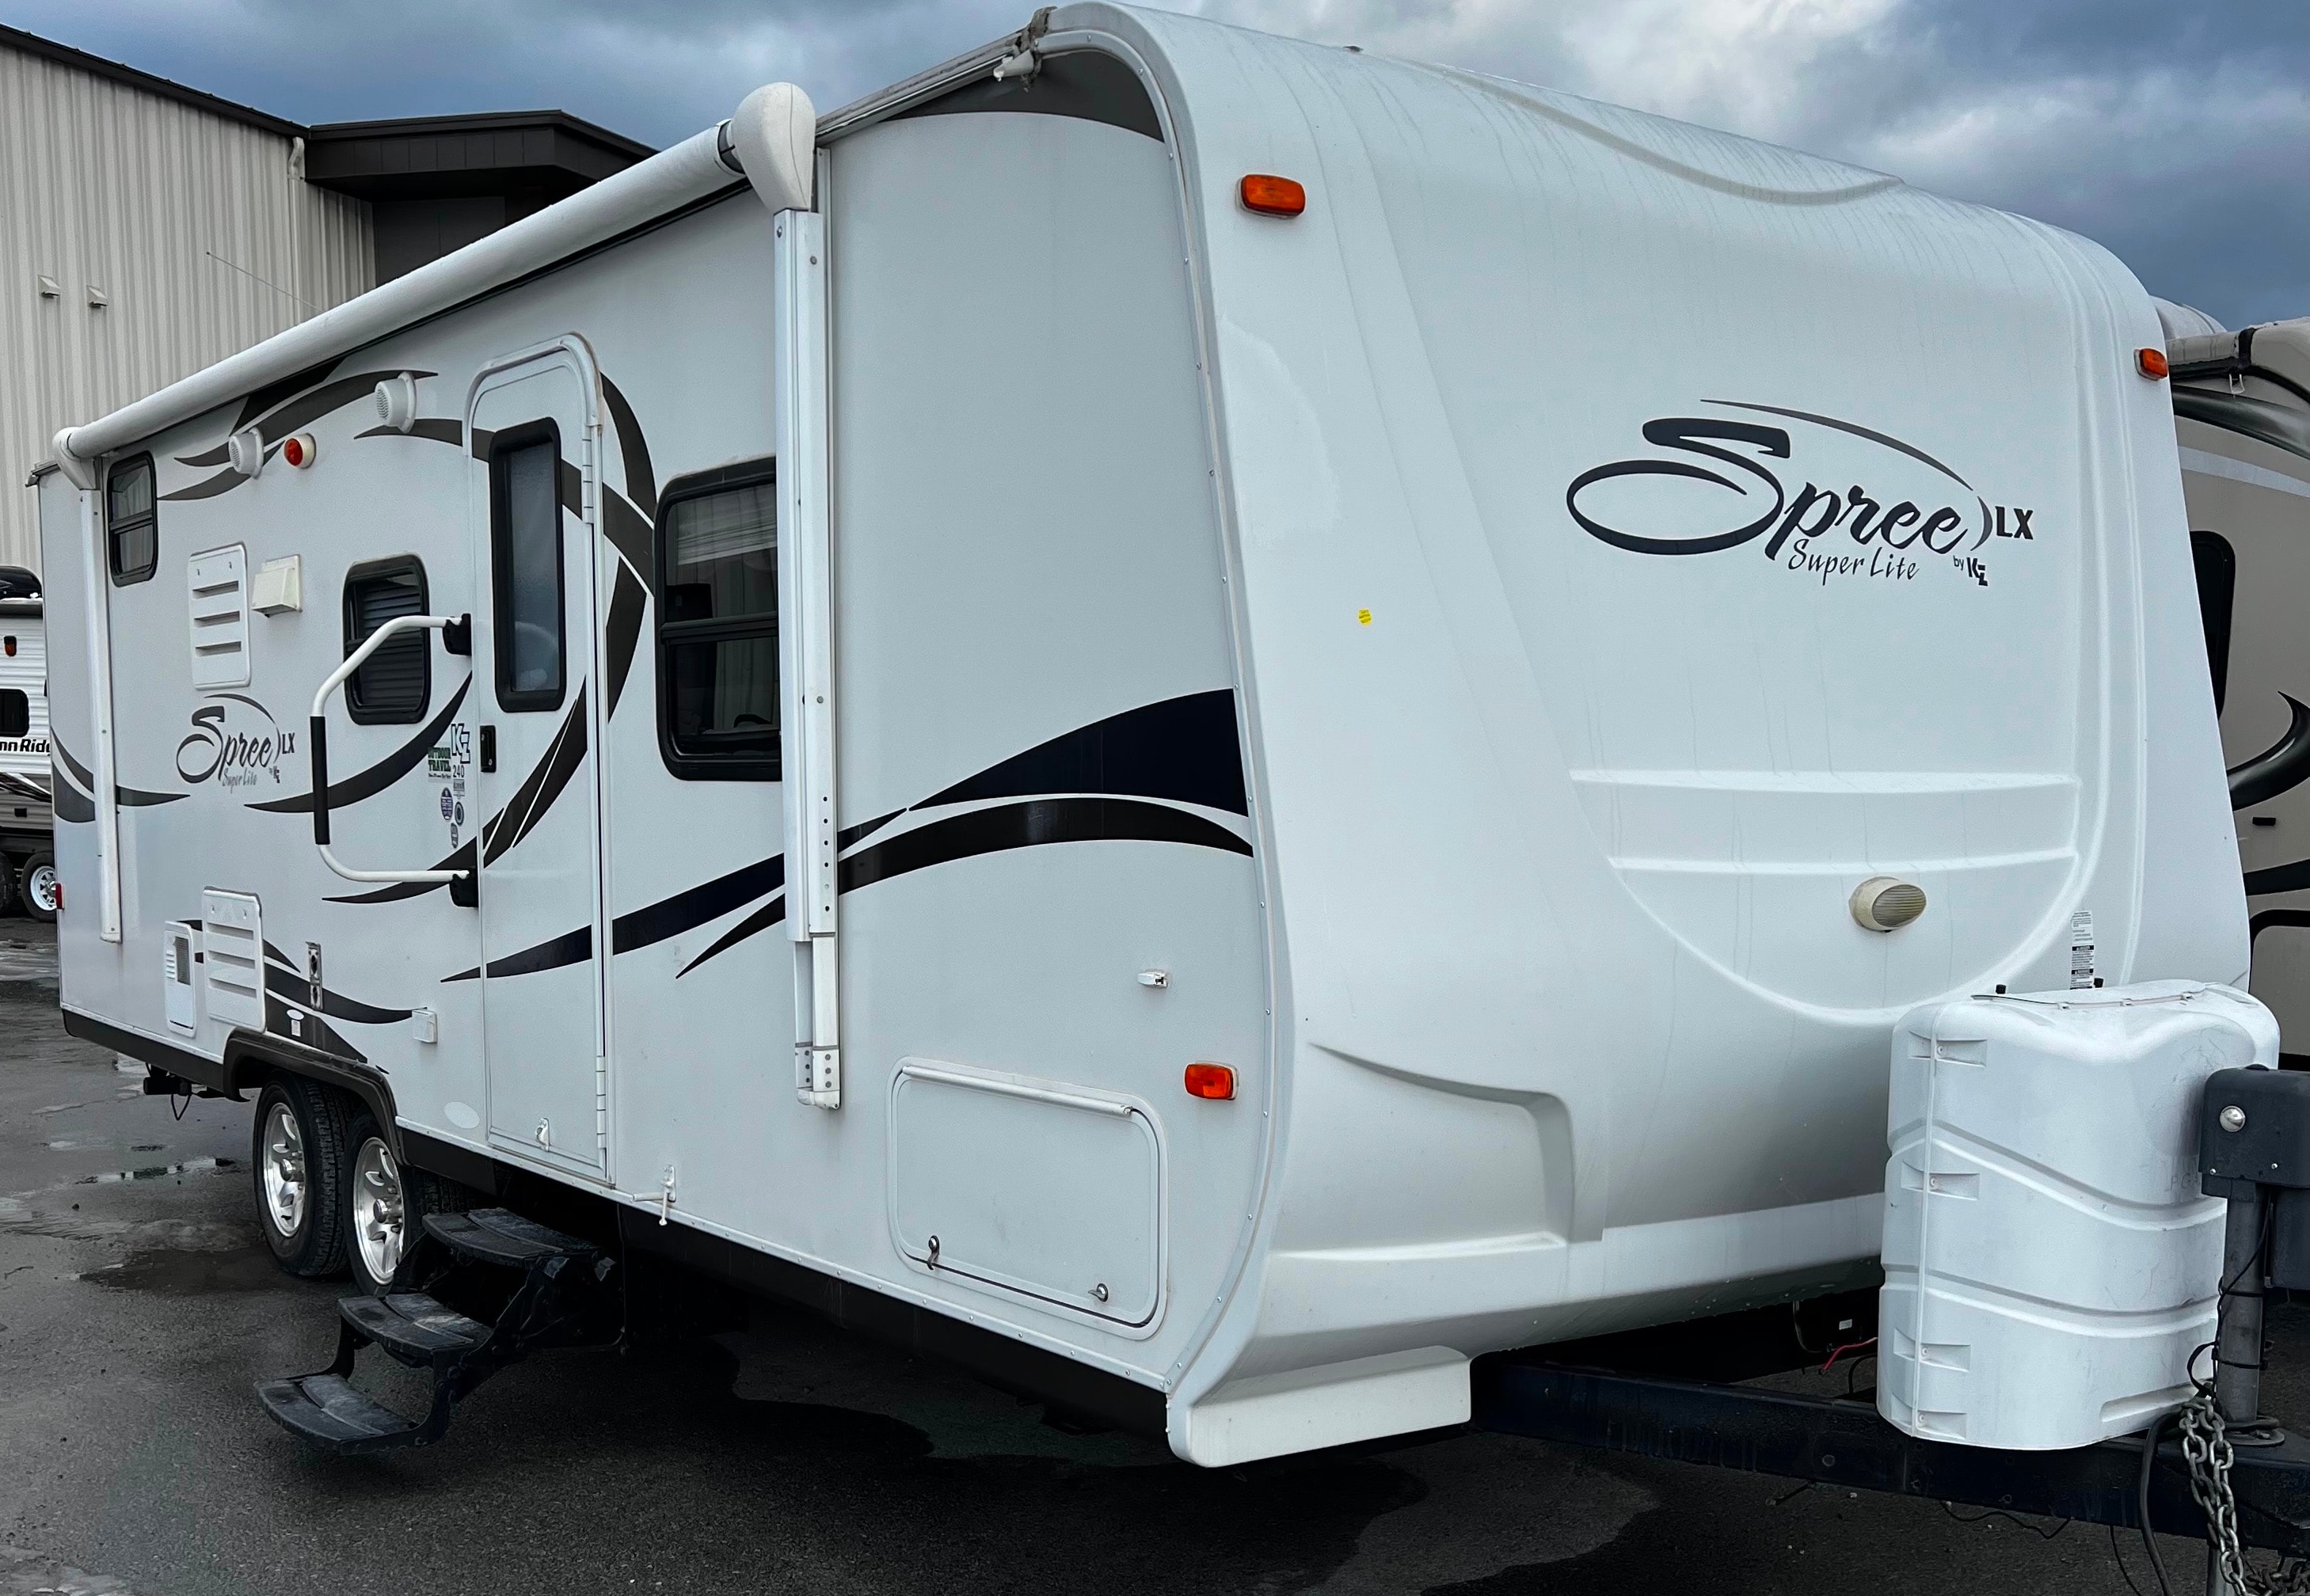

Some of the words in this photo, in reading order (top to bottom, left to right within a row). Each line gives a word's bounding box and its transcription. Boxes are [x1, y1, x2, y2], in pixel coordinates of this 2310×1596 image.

[1566, 417, 1969, 560] Spree
[1995, 505, 2033, 540] LX
[1788, 538, 1865, 586] Super
[1870, 546, 1920, 580] Lite
[1953, 555, 1964, 571] by
[176, 705, 274, 785] Spree
[282, 732, 295, 754] LX
[453, 764, 466, 778] 240
